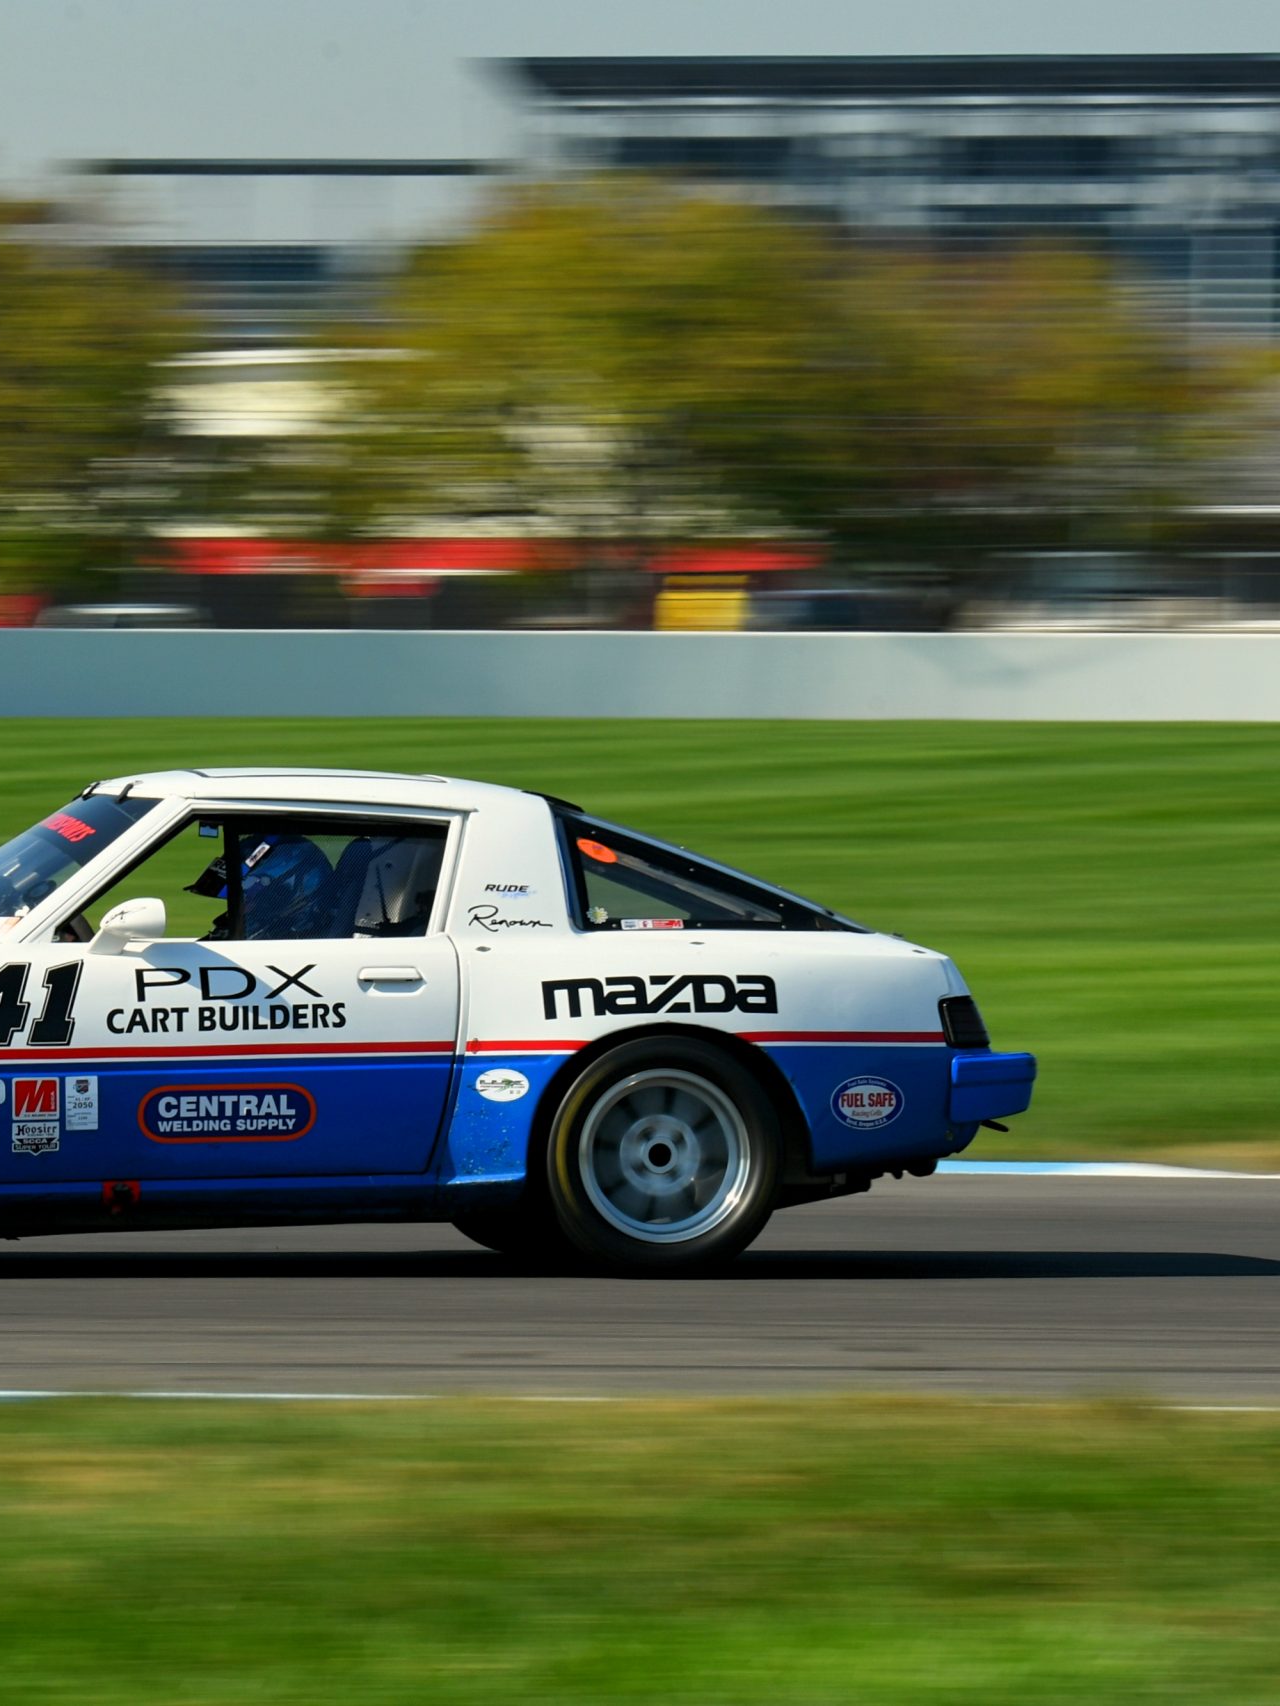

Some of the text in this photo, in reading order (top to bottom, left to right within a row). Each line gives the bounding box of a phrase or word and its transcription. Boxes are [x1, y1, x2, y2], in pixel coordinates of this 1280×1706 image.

[484, 883, 530, 893] RUDE
[135, 963, 324, 1002] PDX
[106, 1002, 347, 1034] CART BUILDERS
[158, 1094, 296, 1118] CENTRAL
[841, 1092, 895, 1108] FUEL SAFE
[15, 1123, 57, 1137] Hoosier
[157, 1118, 296, 1133] WELDING SUPPLY
